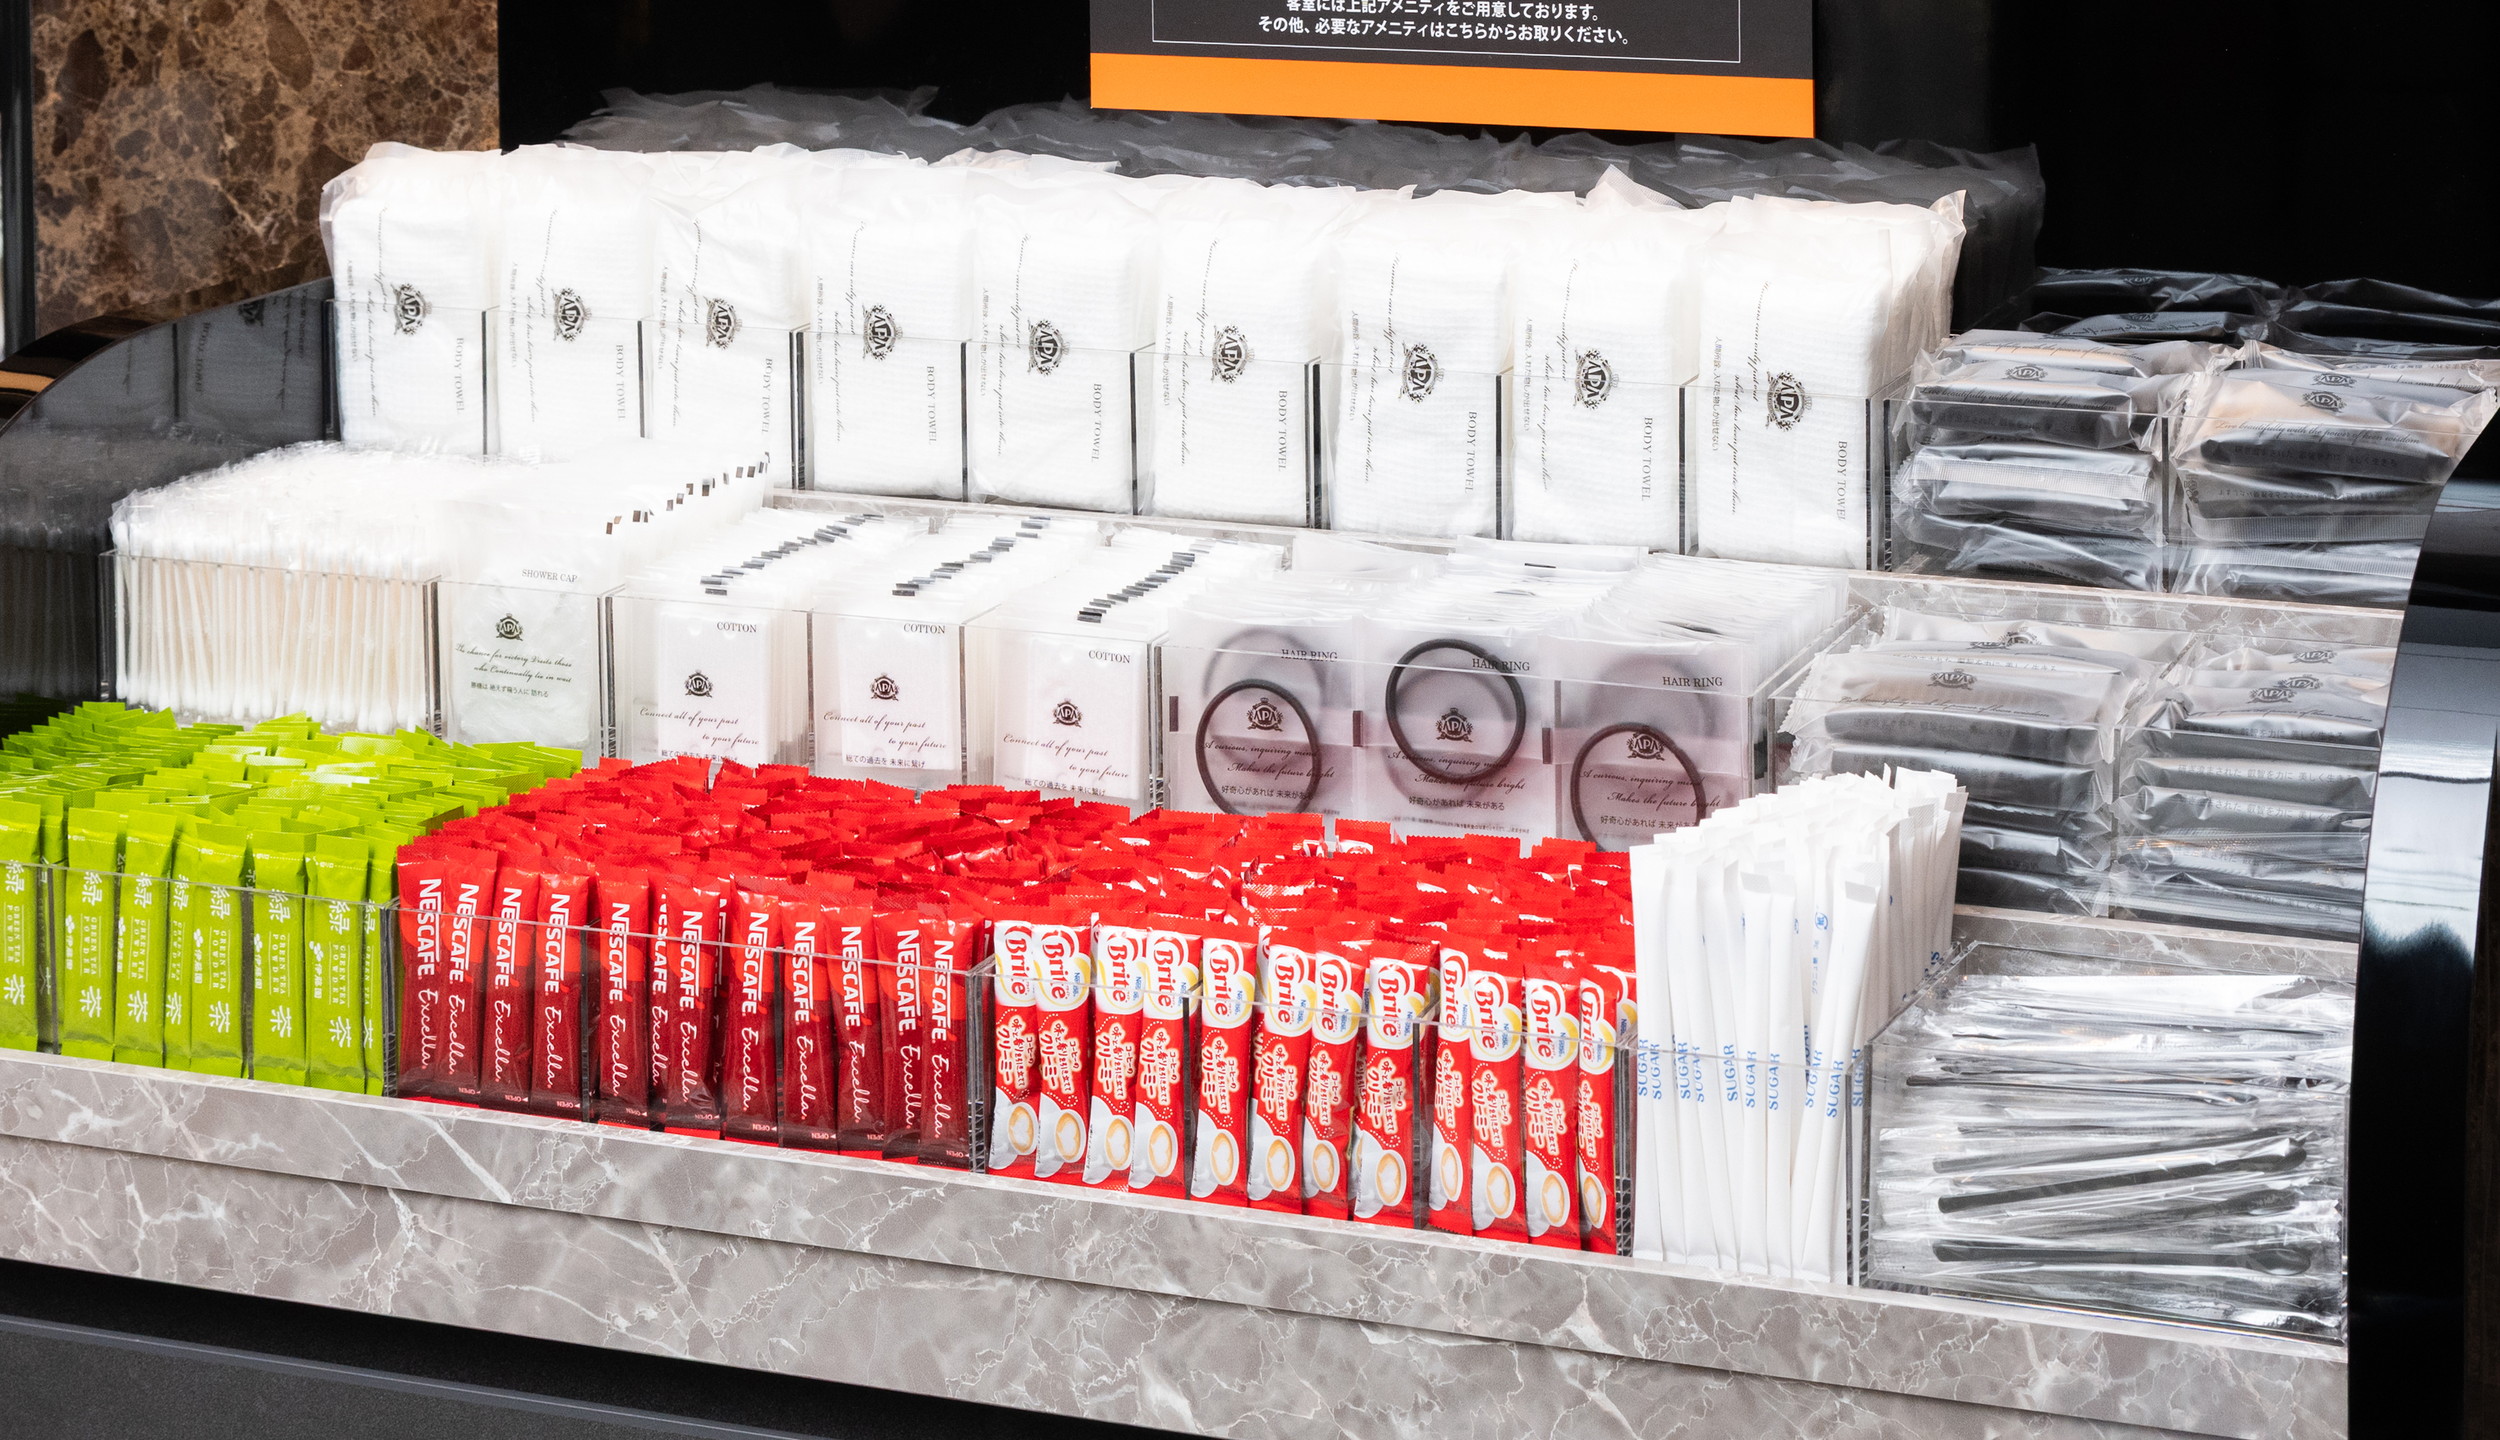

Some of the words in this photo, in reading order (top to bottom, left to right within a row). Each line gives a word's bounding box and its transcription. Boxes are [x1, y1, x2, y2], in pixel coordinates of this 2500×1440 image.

[1258, 16, 1629, 44] その他、必要なアメニティはこちらからお取りください。
[926, 365, 935, 398] BODY
[1092, 383, 1102, 416] BODY
[927, 403, 936, 445] TOWEL
[1279, 390, 1287, 424] BODY
[1466, 411, 1477, 444] BODY
[1091, 420, 1100, 462] TOWEL
[1278, 429, 1287, 472] TOWEL
[1643, 417, 1652, 450] BODY
[2239, 423, 2285, 439] beautifully
[2286, 426, 2307, 434] with
[2308, 427, 2322, 436] the
[2319, 429, 2351, 442] power
[2386, 433, 2420, 445] wisdom
[1465, 451, 1475, 493] TOWEL
[1642, 457, 1651, 501] TOWEL
[1838, 441, 1847, 476] BODY
[1837, 480, 1846, 520] TOWEL
[522, 569, 558, 581] SHOWER
[560, 574, 577, 582] CAP
[717, 622, 756, 632] COTTON
[904, 623, 945, 634] COTTON
[1089, 651, 1131, 663] COTTON
[1472, 659, 1498, 669] HAIR
[1502, 661, 1530, 671] RING
[1663, 677, 1691, 686] HAIR
[1694, 677, 1723, 688] RING
[1003, 734, 1038, 746] Connect
[1041, 740, 1052, 748] all
[1055, 740, 1069, 755] of
[1065, 747, 1085, 757] your
[1085, 749, 1108, 760] past
[1079, 767, 1099, 777] your
[1099, 765, 1128, 780] future
[1222, 786, 1274, 797] 好奇心があれば
[1630, 775, 1674, 789] inquiring
[1467, 801, 1504, 811] 未来がある
[1600, 816, 1655, 827] 好奇心があれば
[1607, 792, 1640, 803] Makes
[1644, 794, 1657, 804] the
[1656, 797, 1687, 811] future
[1005, 938, 1027, 995] Brite
[1042, 943, 1069, 1000] Brite
[1108, 945, 1130, 1002] Brite
[1153, 949, 1172, 1009] Brite
[1210, 958, 1230, 1016] Brite
[4, 974, 25, 1005] 茶
[80, 986, 102, 1017] 茶
[1275, 964, 1295, 1024] Brite
[1320, 972, 1340, 1031] Brite
[1378, 978, 1398, 1038] Brite
[1443, 967, 1460, 1031] Brite
[209, 1001, 230, 1033] 茶
[270, 1005, 291, 1038] 茶
[329, 1016, 351, 1048] 茶
[419, 988, 438, 1067] Excella
[449, 995, 466, 1073] Excella
[1474, 989, 1495, 1050] Brite
[1531, 996, 1551, 1058] Brite
[1581, 1004, 1595, 1067] Brite
[495, 999, 510, 1081] Excella
[545, 1006, 563, 1087] Excella
[610, 1014, 630, 1095] Excella
[1125, 1046, 1133, 1074] コーヒーの
[741, 1027, 760, 1111] Excella
[796, 1035, 816, 1119] Excella
[849, 1040, 870, 1122] Excella
[1098, 1036, 1112, 1089] クリーミー
[1638, 1039, 1648, 1097] SUGAR
[1650, 1043, 1662, 1100] SUGAR
[1677, 1042, 1691, 1100] SUGAR
[1724, 1044, 1738, 1101] SUGAR
[1746, 1051, 1757, 1108] SUGAR
[1769, 1053, 1780, 1111] SUGAR
[1805, 1050, 1823, 1108] SUGAR
[900, 1045, 921, 1127] Excella
[932, 1054, 953, 1137] Excella
[1826, 1060, 1844, 1118] SUGAR
